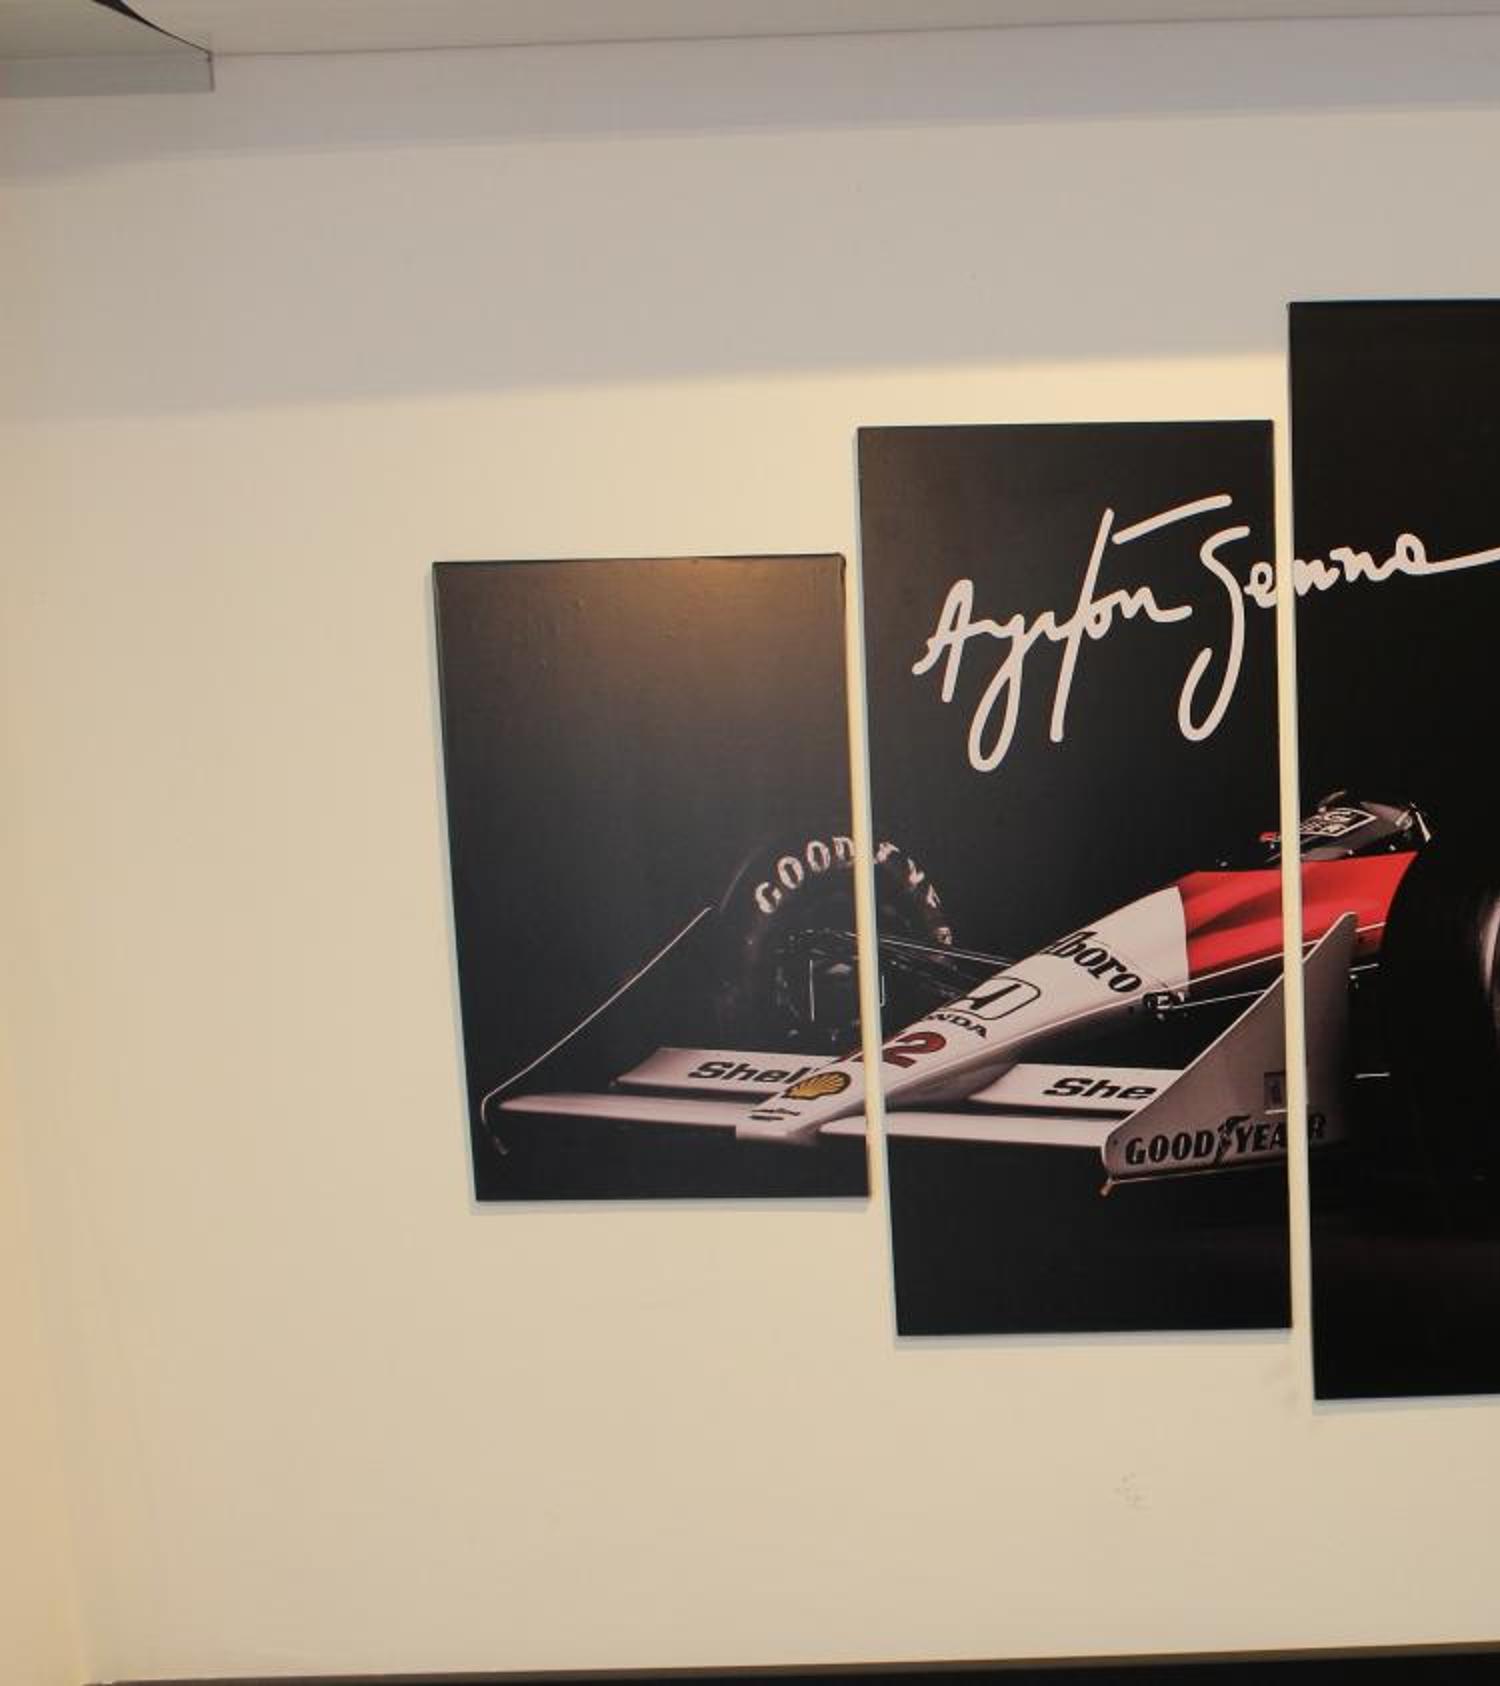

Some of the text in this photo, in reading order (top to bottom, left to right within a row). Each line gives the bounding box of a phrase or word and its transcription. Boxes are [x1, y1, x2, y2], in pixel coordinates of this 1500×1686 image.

[912, 494, 1233, 772] Ayrton
[927, 1012, 987, 1039] NDA
[1042, 1076, 1158, 1100] She
[1124, 1112, 1327, 1166] GOODYEAR
